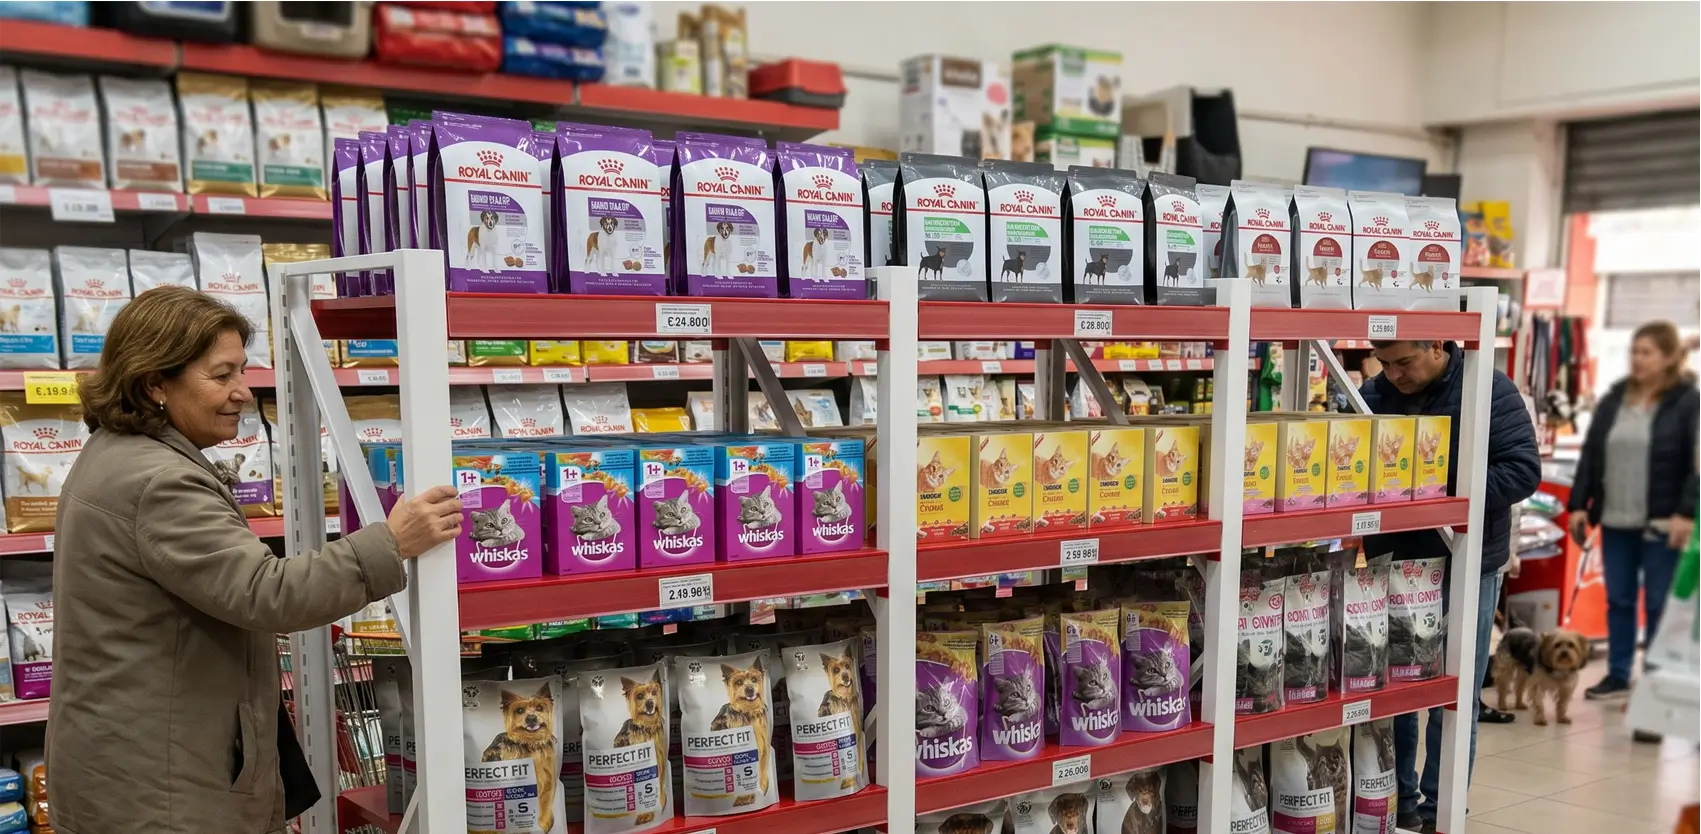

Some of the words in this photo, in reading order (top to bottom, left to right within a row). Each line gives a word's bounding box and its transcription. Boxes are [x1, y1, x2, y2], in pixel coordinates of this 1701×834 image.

[459, 166, 491, 180] ROYAL
[494, 169, 528, 182] CANIN
[579, 174, 612, 187] ROYAL
[614, 177, 648, 189] CANIN
[697, 181, 728, 193] ROYAL
[730, 184, 762, 195] CANIN
[797, 189, 823, 200] ROYAL
[825, 190, 853, 202] CANIN
[917, 198, 945, 209] ROYAL
[948, 200, 976, 210] CANIN
[1000, 203, 1025, 214] ROYAL
[1027, 204, 1055, 215] CANIN
[1083, 208, 1109, 218] ROYAL
[1111, 209, 1135, 219] CANIN
[1383, 227, 1402, 235] CANIN
[454, 428, 482, 436] CANIN
[529, 427, 554, 435] CANIN
[14, 440, 47, 450] ROYAL
[49, 439, 82, 450] CANIN
[738, 528, 784, 544] whiskas
[812, 522, 855, 538] whiskas
[571, 540, 624, 557] whiskas
[653, 534, 704, 550] whiskas
[469, 545, 528, 563] whiskas
[18, 611, 50, 620] ROYAL
[796, 719, 837, 735] PERFECT
[839, 716, 850, 728] FIT
[1071, 708, 1119, 731] whiska
[688, 733, 734, 748] PERFECT
[737, 731, 751, 743] FIT
[588, 750, 636, 766] PERFECT
[638, 747, 652, 760] FIT
[465, 766, 508, 780] ERFECT
[511, 764, 529, 777] FIT
[743, 766, 753, 777] S
[644, 783, 653, 794] S
[1360, 775, 1388, 790] PERFECT
[1279, 793, 1318, 808] PERFECT
[1319, 791, 1331, 805] FIT
[517, 802, 529, 814] S
